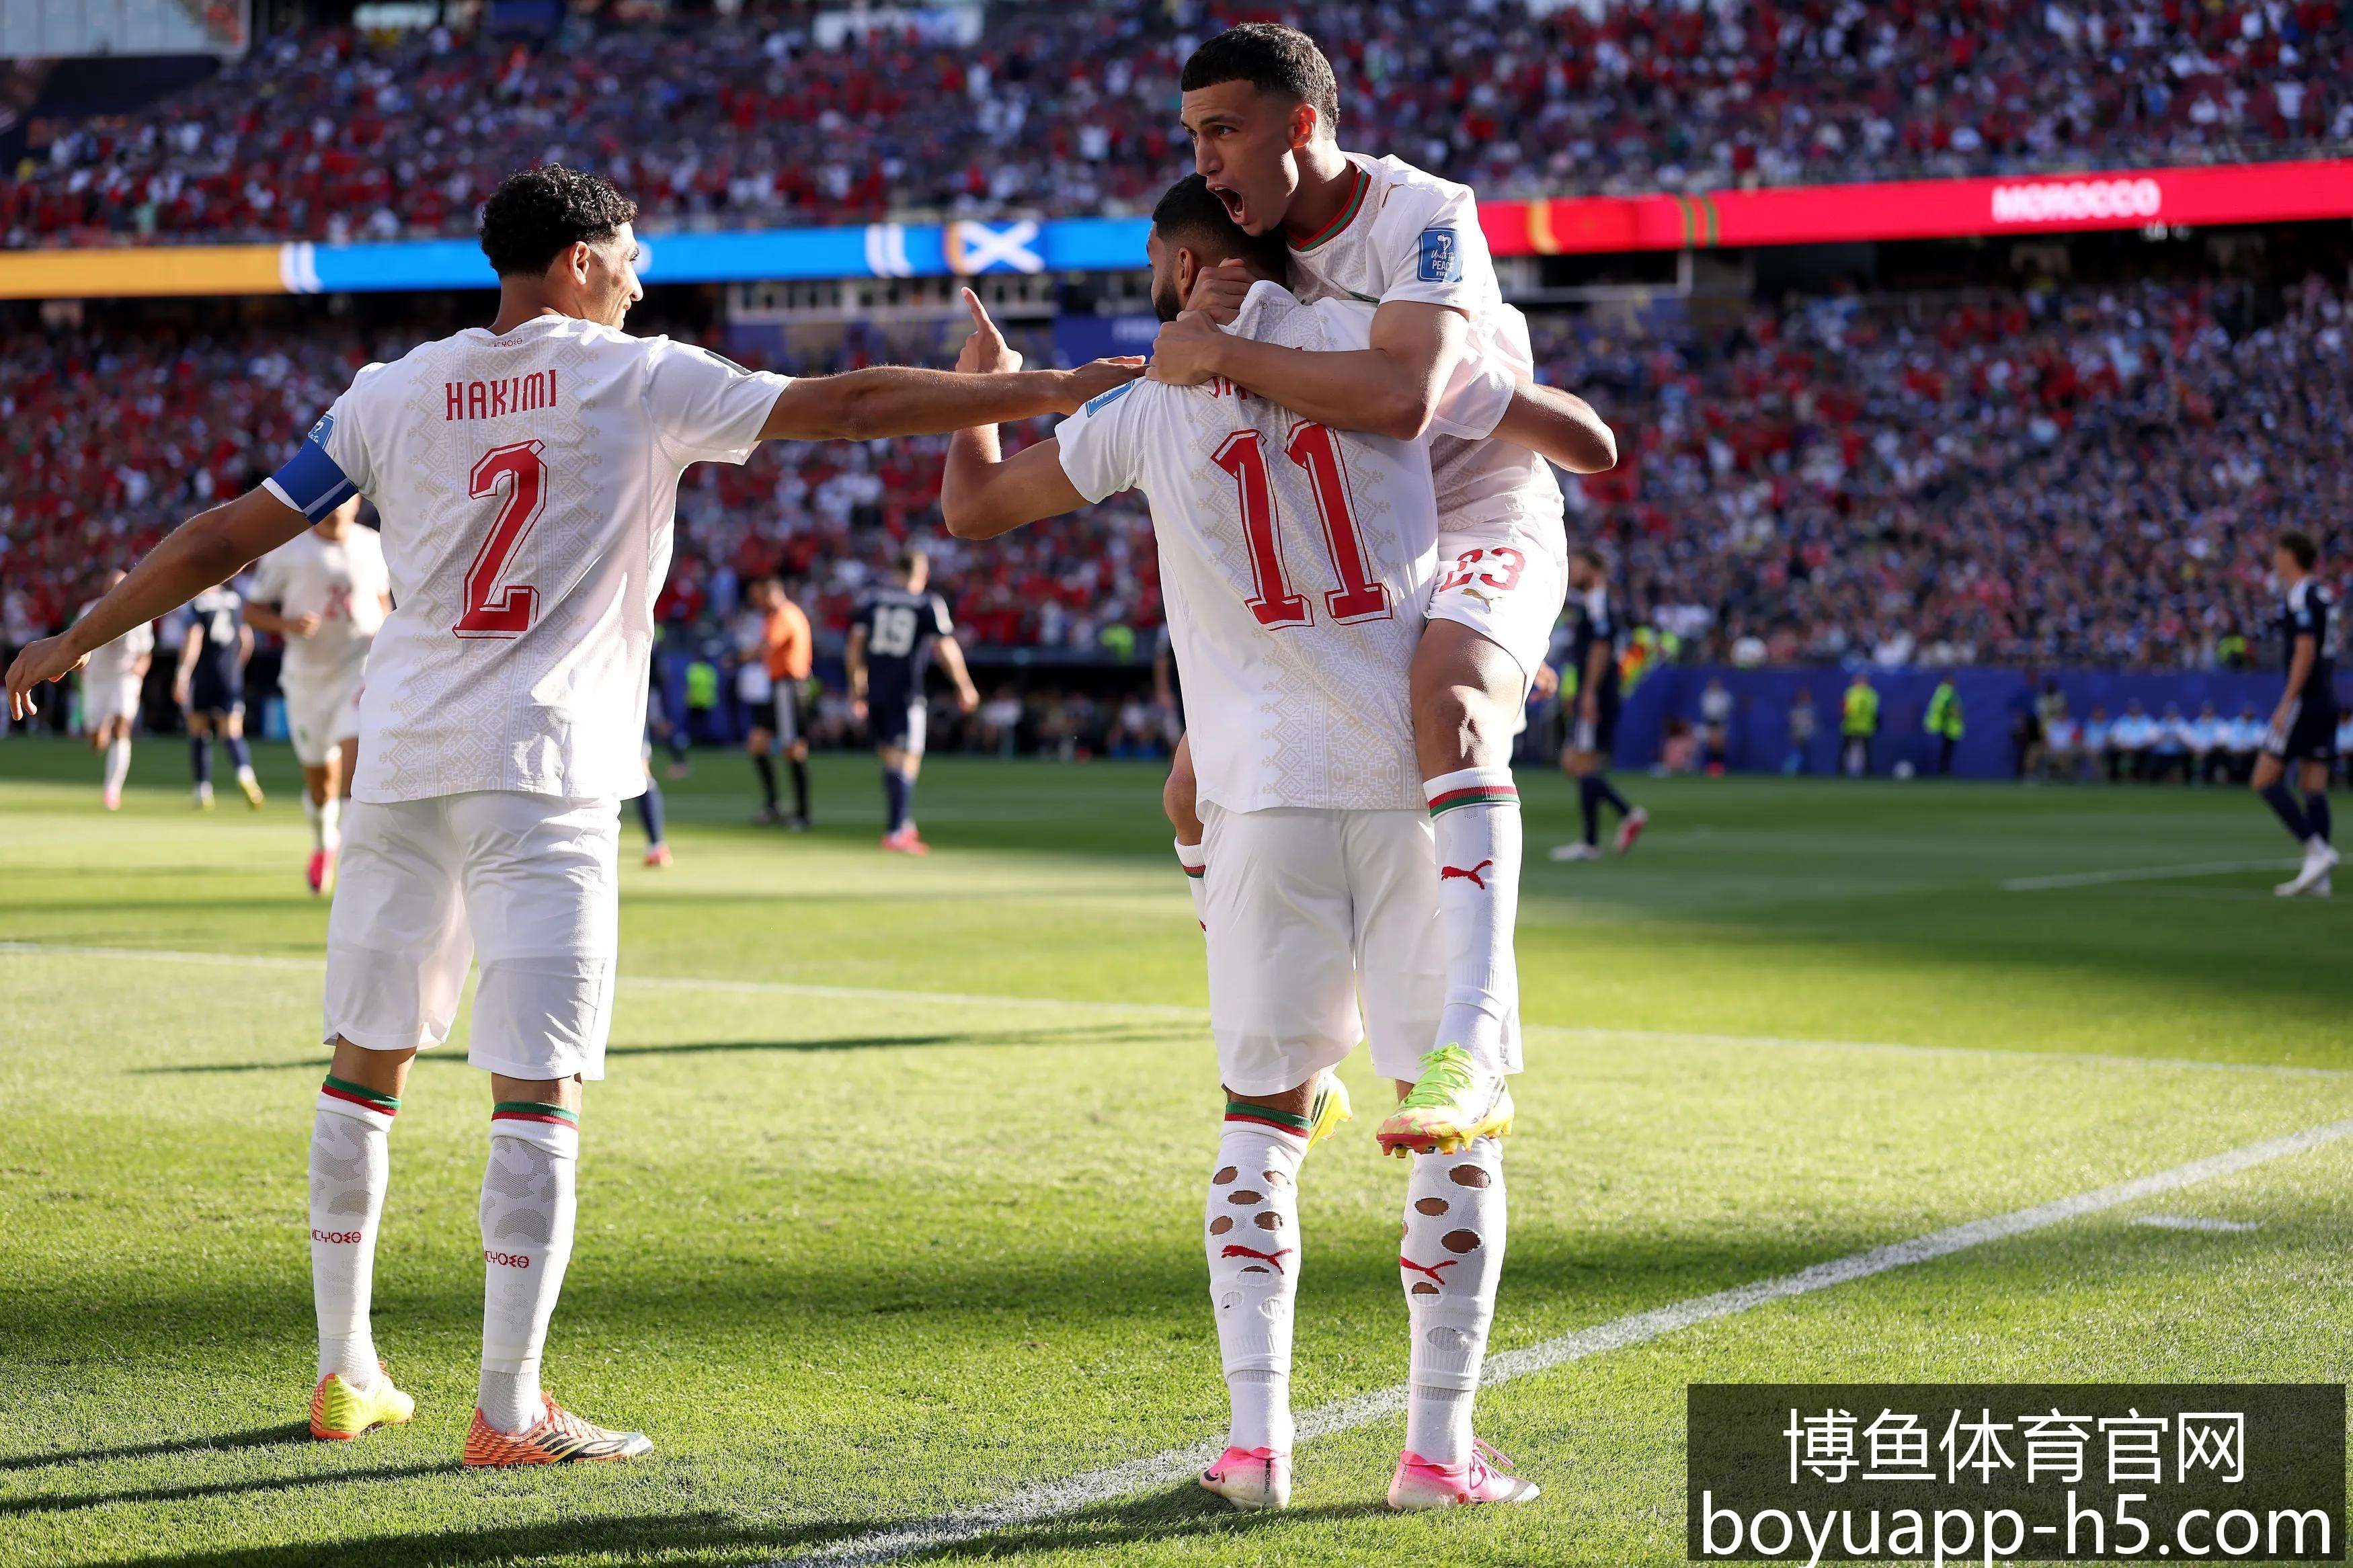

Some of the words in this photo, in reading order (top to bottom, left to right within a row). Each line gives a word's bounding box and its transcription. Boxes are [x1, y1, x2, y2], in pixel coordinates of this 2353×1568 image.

[1991, 179, 2161, 222] MOROCCO
[446, 369, 556, 421] HAKIMI
[452, 439, 548, 638] 2
[1210, 419, 1393, 630] 11
[1439, 547, 1525, 592] 23
[870, 606, 918, 657] 19
